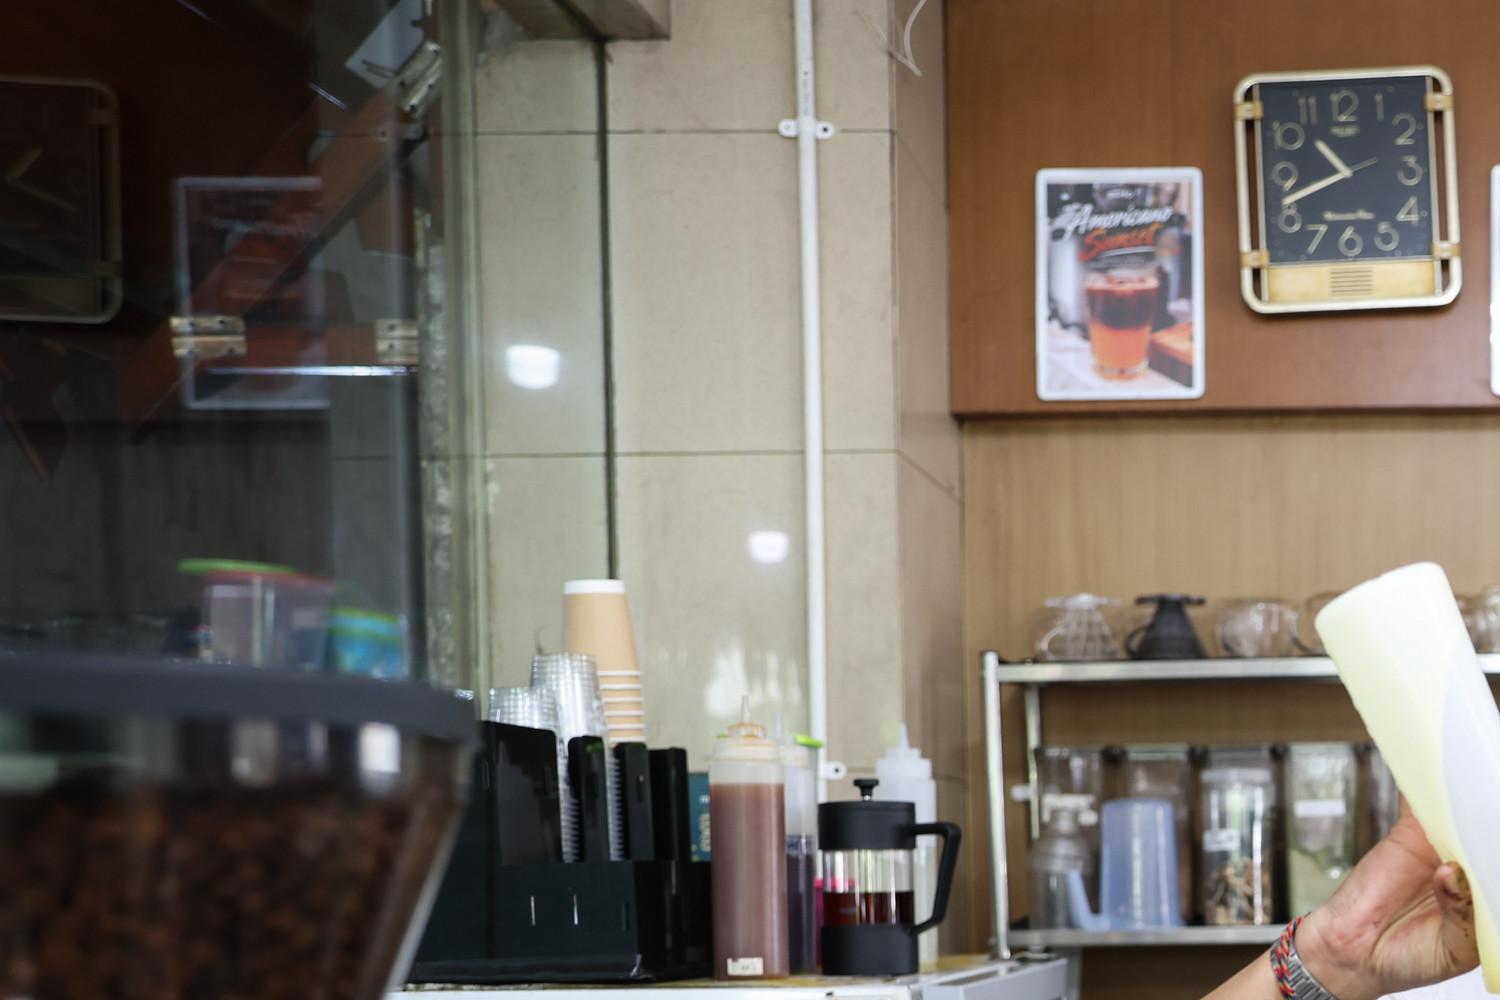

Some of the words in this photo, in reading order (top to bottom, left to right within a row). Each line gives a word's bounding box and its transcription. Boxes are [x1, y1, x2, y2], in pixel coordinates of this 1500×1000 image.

[1297, 95, 1319, 126] 11
[1330, 89, 1359, 122] 12
[1374, 93, 1385, 122] 1
[1272, 120, 1305, 152] 10
[1391, 112, 1417, 145] 2
[1272, 161, 1299, 192] 9
[1396, 155, 1424, 186] 3
[1054, 203, 1173, 241] Americano
[1278, 203, 1303, 234] 8
[1394, 195, 1420, 226] 4
[1305, 223, 1329, 255] 7
[1338, 225, 1364, 257] 6
[1374, 221, 1400, 252] 5
